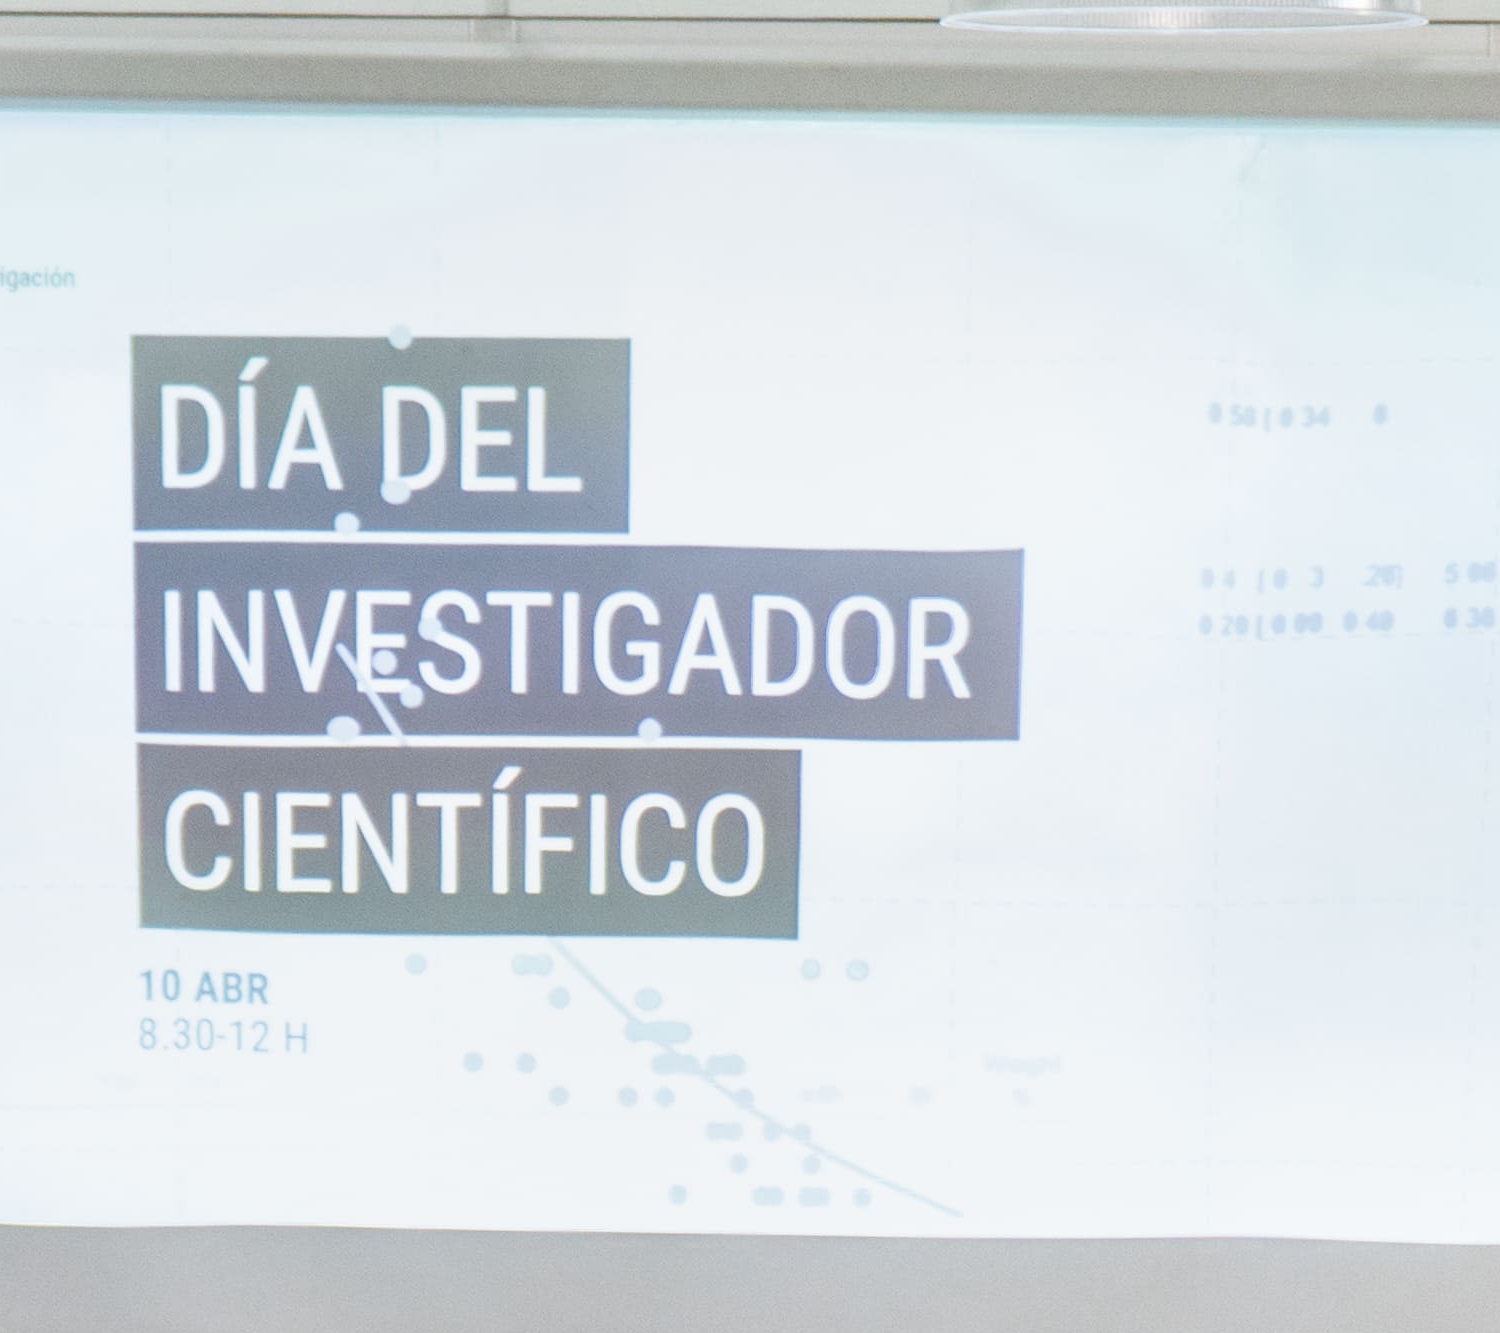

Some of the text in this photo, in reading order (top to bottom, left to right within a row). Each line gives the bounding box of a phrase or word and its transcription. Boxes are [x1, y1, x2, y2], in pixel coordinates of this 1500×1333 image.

[160, 357, 583, 492] DÍA DEL
[163, 589, 972, 700] INVESTIGADOR
[164, 766, 766, 898] CIENTÍFICO
[139, 968, 269, 1005] 10 ABR
[139, 1017, 308, 1054] 8.30-12 H
